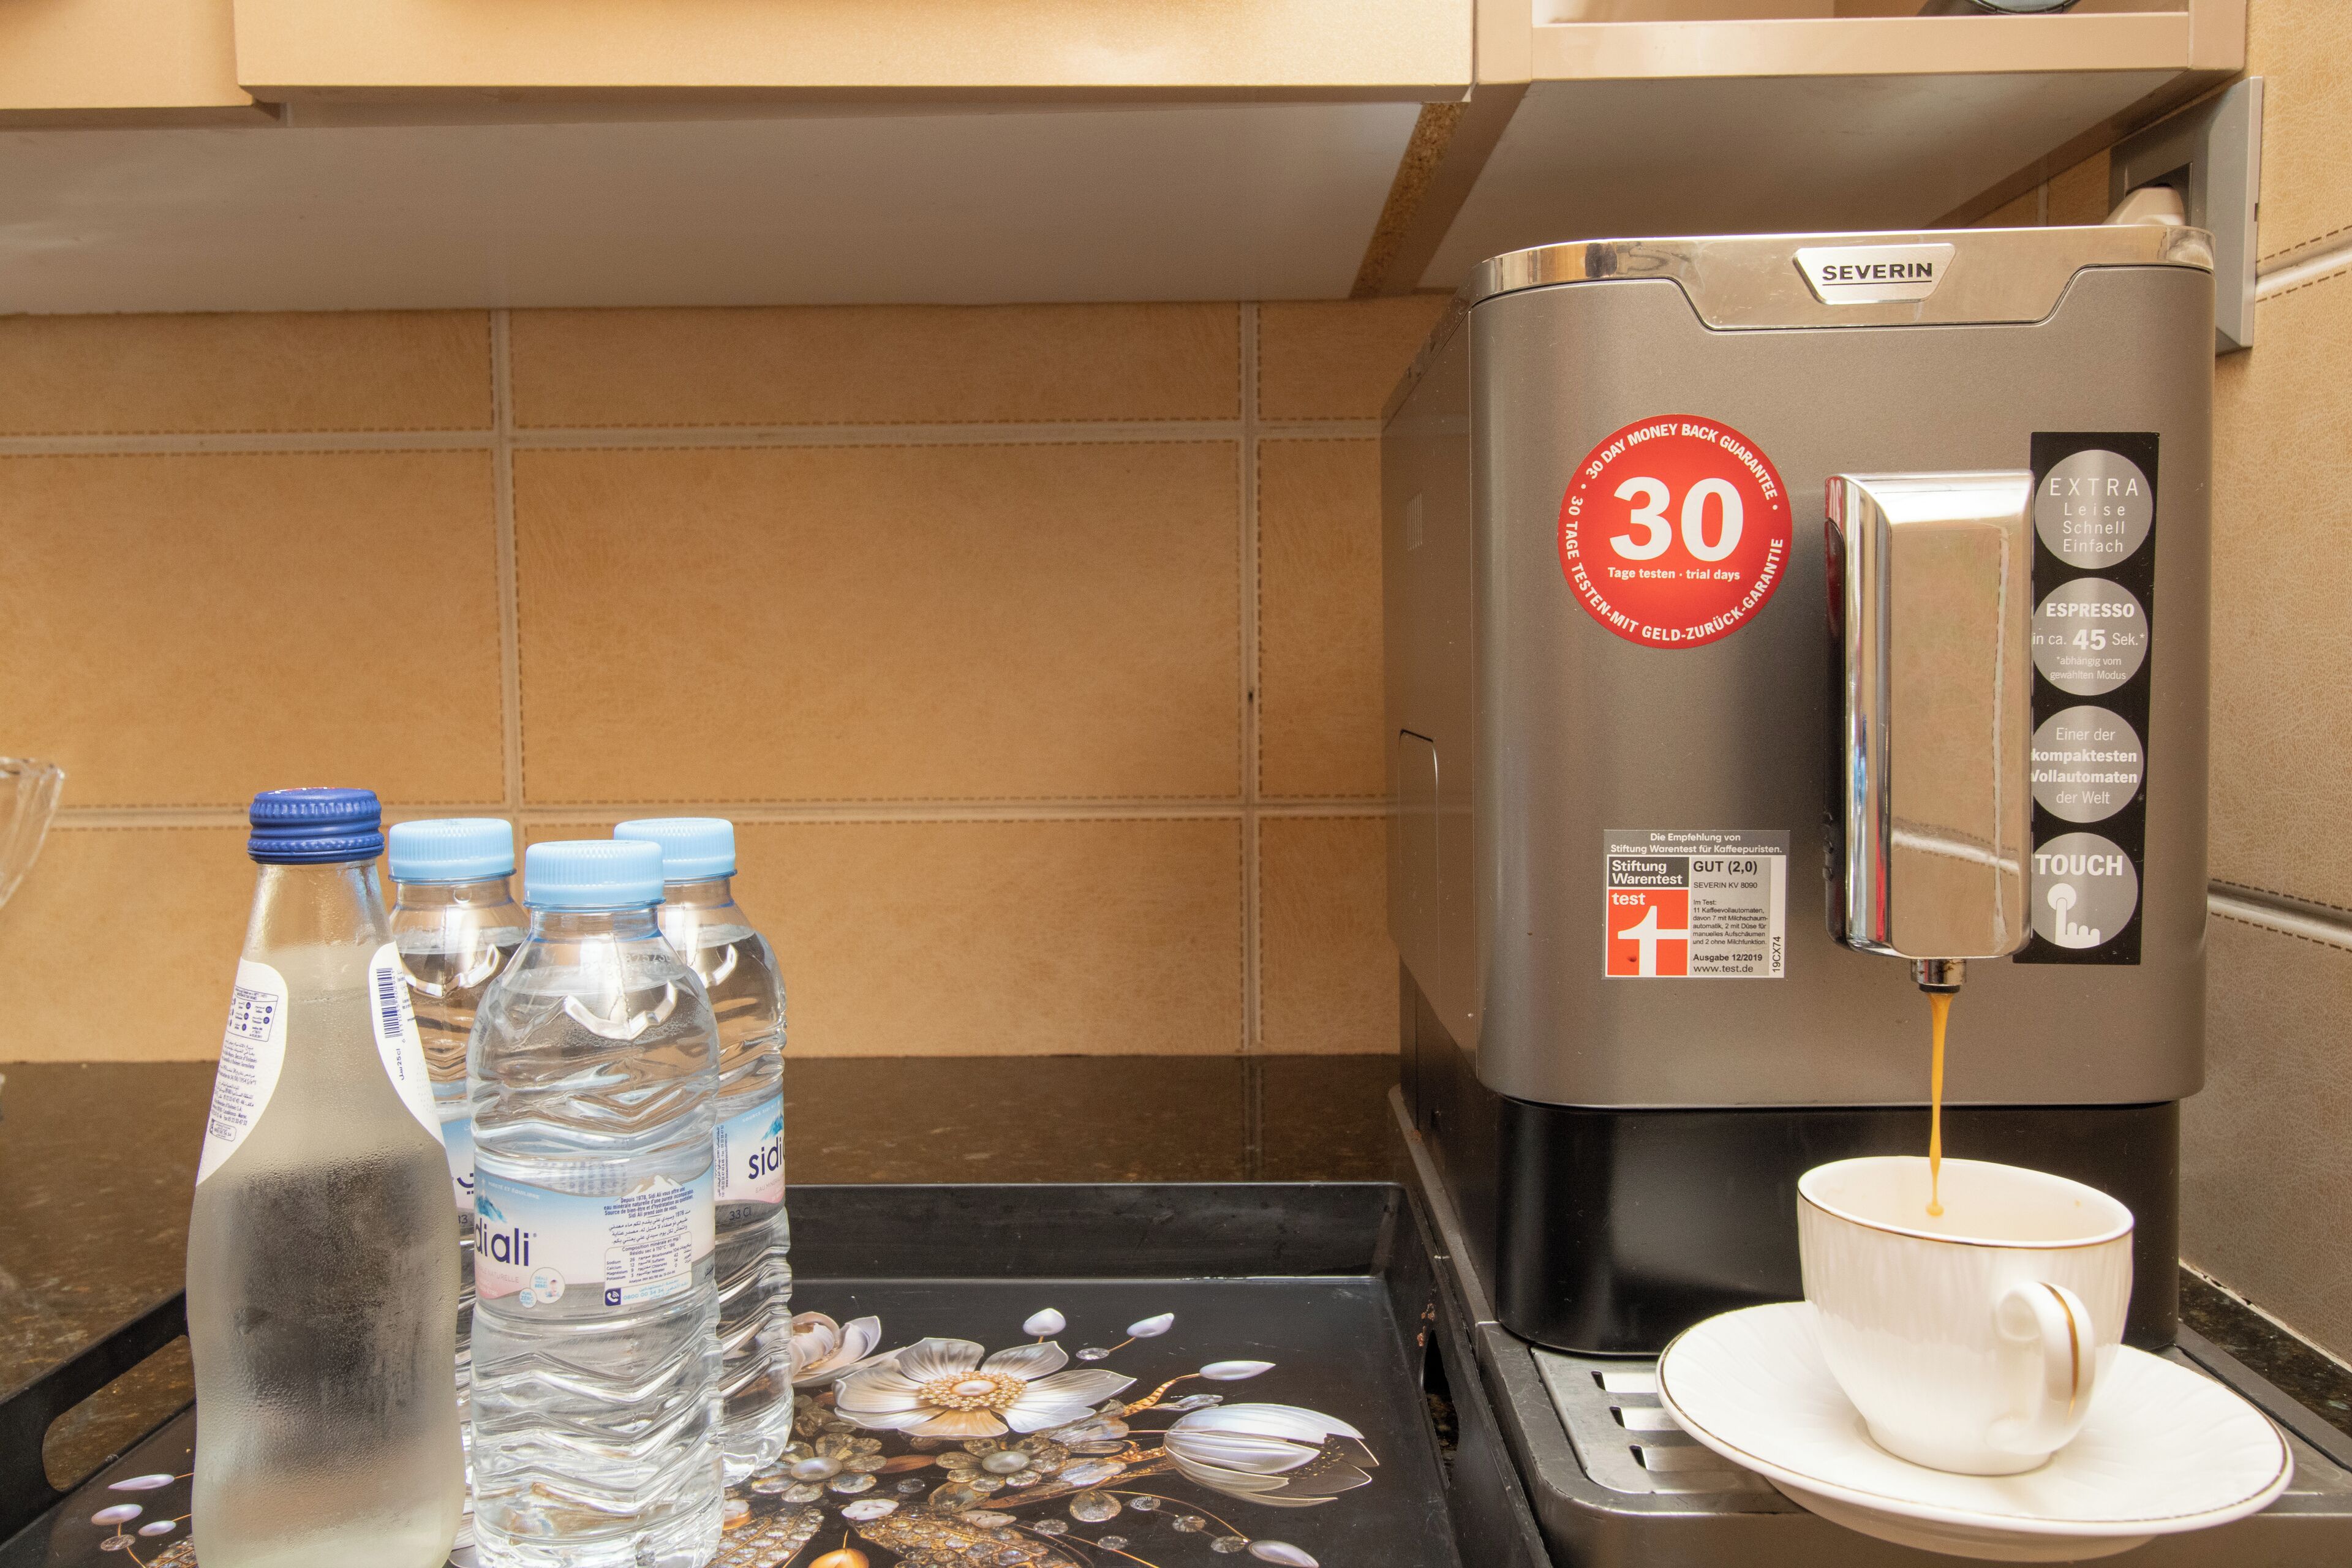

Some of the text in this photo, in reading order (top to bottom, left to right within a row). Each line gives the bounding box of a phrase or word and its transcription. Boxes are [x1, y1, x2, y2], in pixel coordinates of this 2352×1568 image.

[1822, 263, 1932, 281] SEVERIN
[1586, 423, 1778, 500] 30 DAY MONEY BACK GUARANTEE
[2049, 478, 2138, 496] EXTRA
[2064, 502, 2125, 516] Leise
[1609, 477, 1744, 562] 30
[2063, 521, 2125, 535] Schnell
[2063, 539, 2123, 552] Einfach
[1566, 496, 1784, 641] 30 TAGE TESTEN-MIT GELD-ZURÜCK-GARANTIE
[1608, 567, 1740, 582] Tage testen trial days
[2046, 603, 2135, 618] ESPRESSO
[2033, 633, 2043, 645] in
[2048, 635, 2067, 645] ca.
[2073, 629, 2106, 650] 45
[2050, 671, 2126, 680] gewählten Modus
[2056, 727, 2116, 741] Einer der
[2031, 748, 2137, 764] kompaktesten
[2056, 791, 2110, 804] der Welt
[1668, 833, 1722, 843] Empfehlung
[1611, 844, 1647, 854] Stiftung
[1714, 845, 1782, 854] Kaffeepuristen.
[1612, 860, 1667, 874] Stiftung
[1693, 861, 1757, 875] GUT (2,0)
[2035, 854, 2123, 876] TOUCH
[1612, 873, 1683, 884] Warentest
[1611, 892, 1646, 905] test
[1773, 936, 1781, 973] 19CX74
[748, 1136, 782, 1180] sidi
[729, 1209, 741, 1221] 33
[491, 1228, 529, 1267] ali
[622, 1243, 649, 1252] Composition
[650, 1239, 667, 1248] minérale
